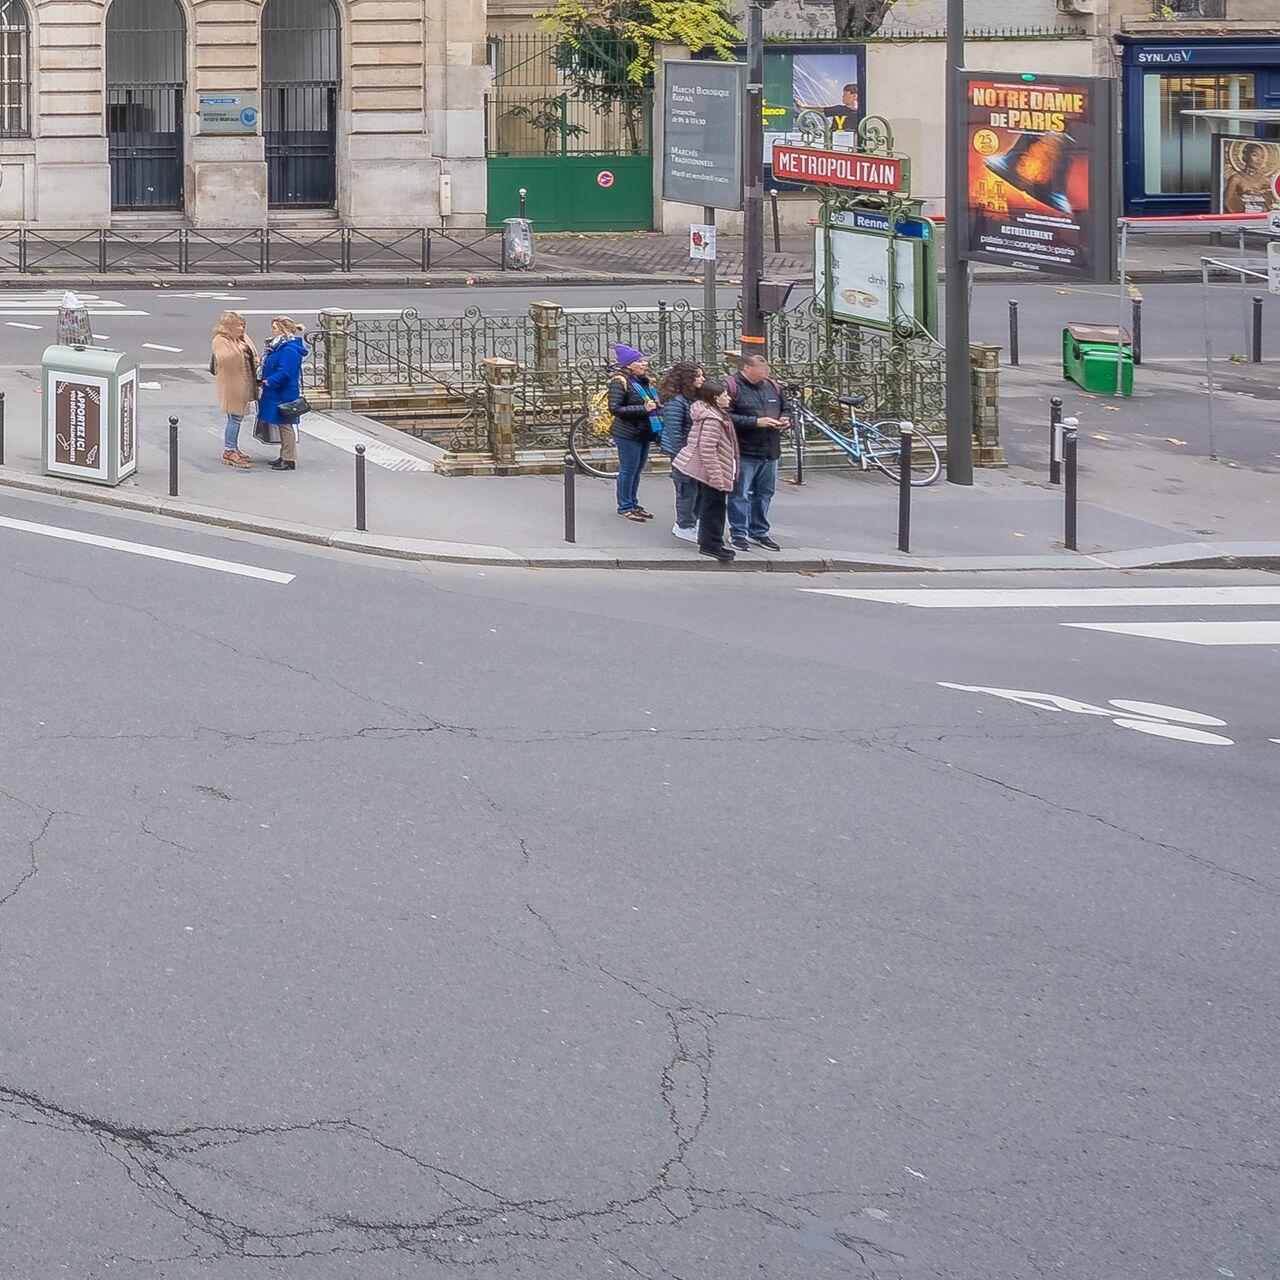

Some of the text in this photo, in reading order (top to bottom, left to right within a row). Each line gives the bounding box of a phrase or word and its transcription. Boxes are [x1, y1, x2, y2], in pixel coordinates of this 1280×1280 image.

[1139, 53, 1182, 63] SYNLAB
[973, 88, 1083, 113] NOTRE DAME
[990, 109, 1065, 132] DE PARIS
[980, 134, 992, 144] 25
[779, 152, 895, 185] METROPOLITAIN
[857, 216, 893, 230] Renne
[1001, 225, 1053, 240] ACTUELLEMENT
[77, 391, 85, 451] APPORTEZ ICI
